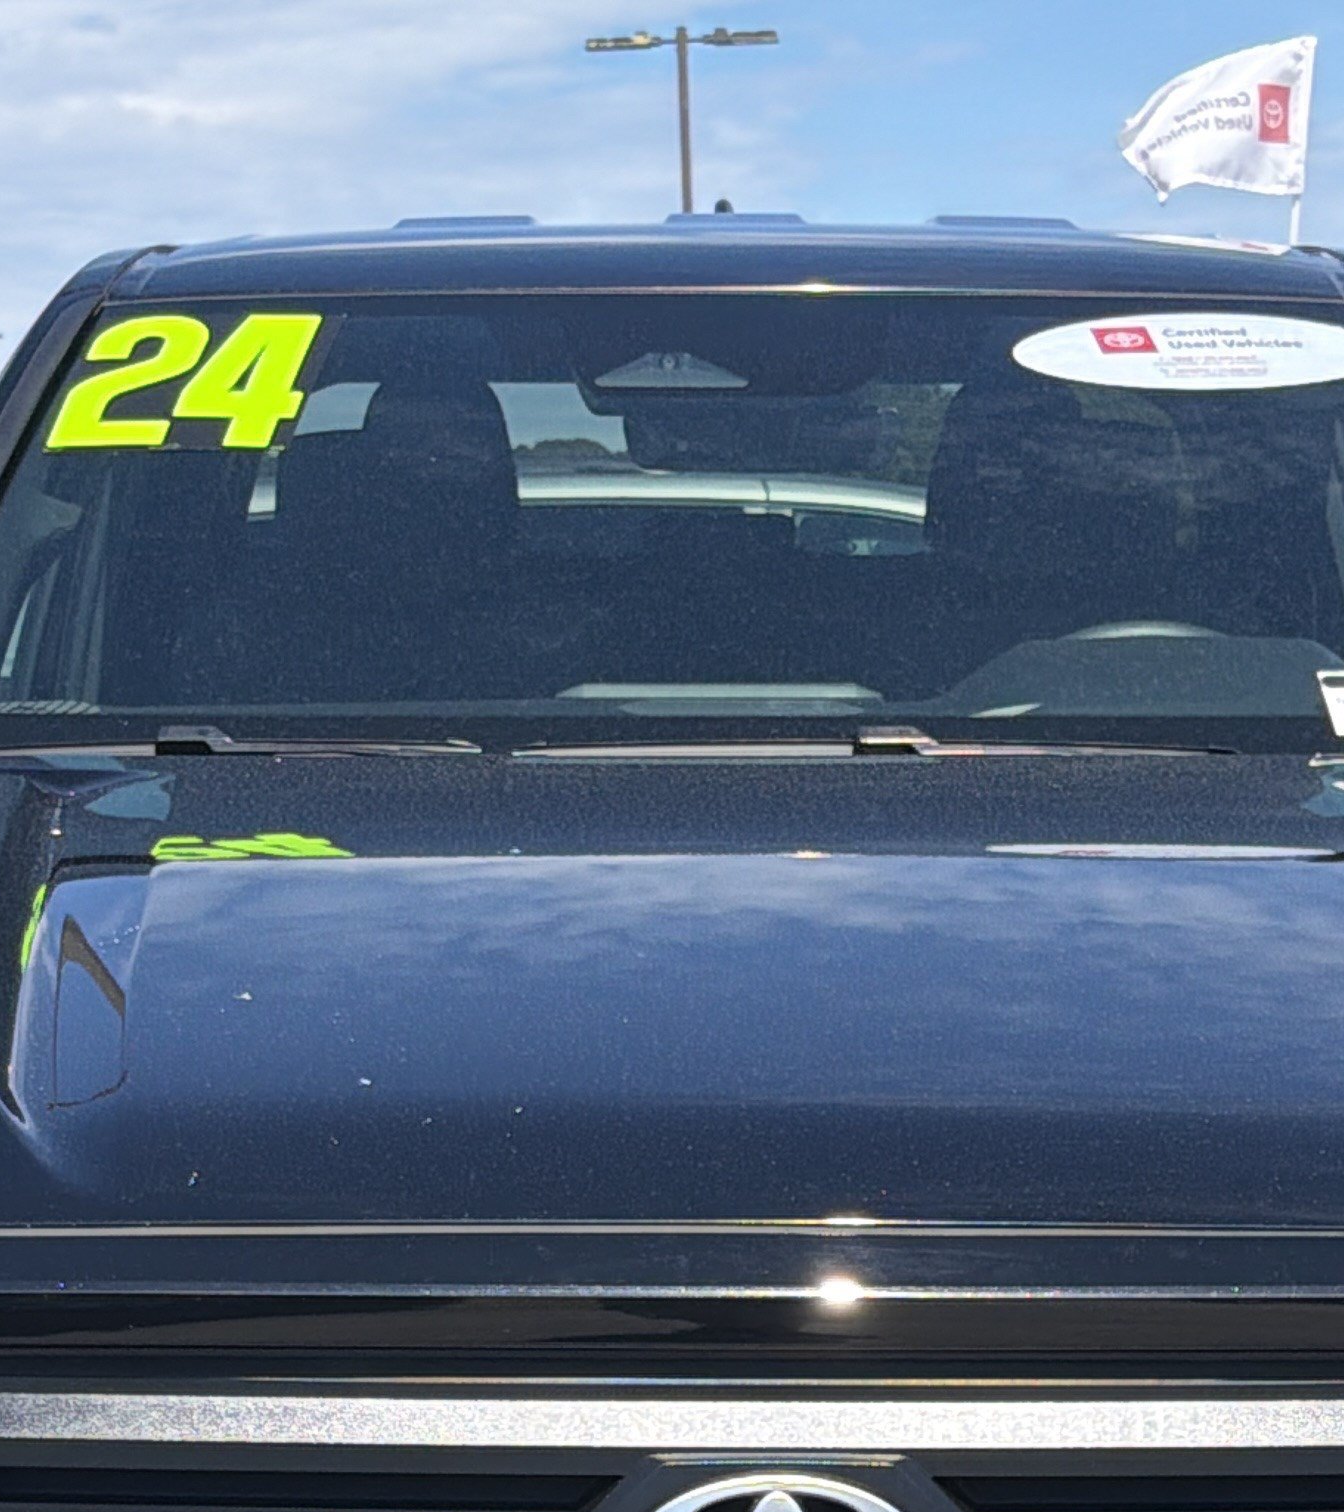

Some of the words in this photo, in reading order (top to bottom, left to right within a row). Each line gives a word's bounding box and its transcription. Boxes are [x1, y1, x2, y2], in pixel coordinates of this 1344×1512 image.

[1161, 326, 1247, 338] Certified
[1167, 339, 1218, 349] Used
[1221, 338, 1304, 349] Vehicles
[45, 313, 323, 449] 24
